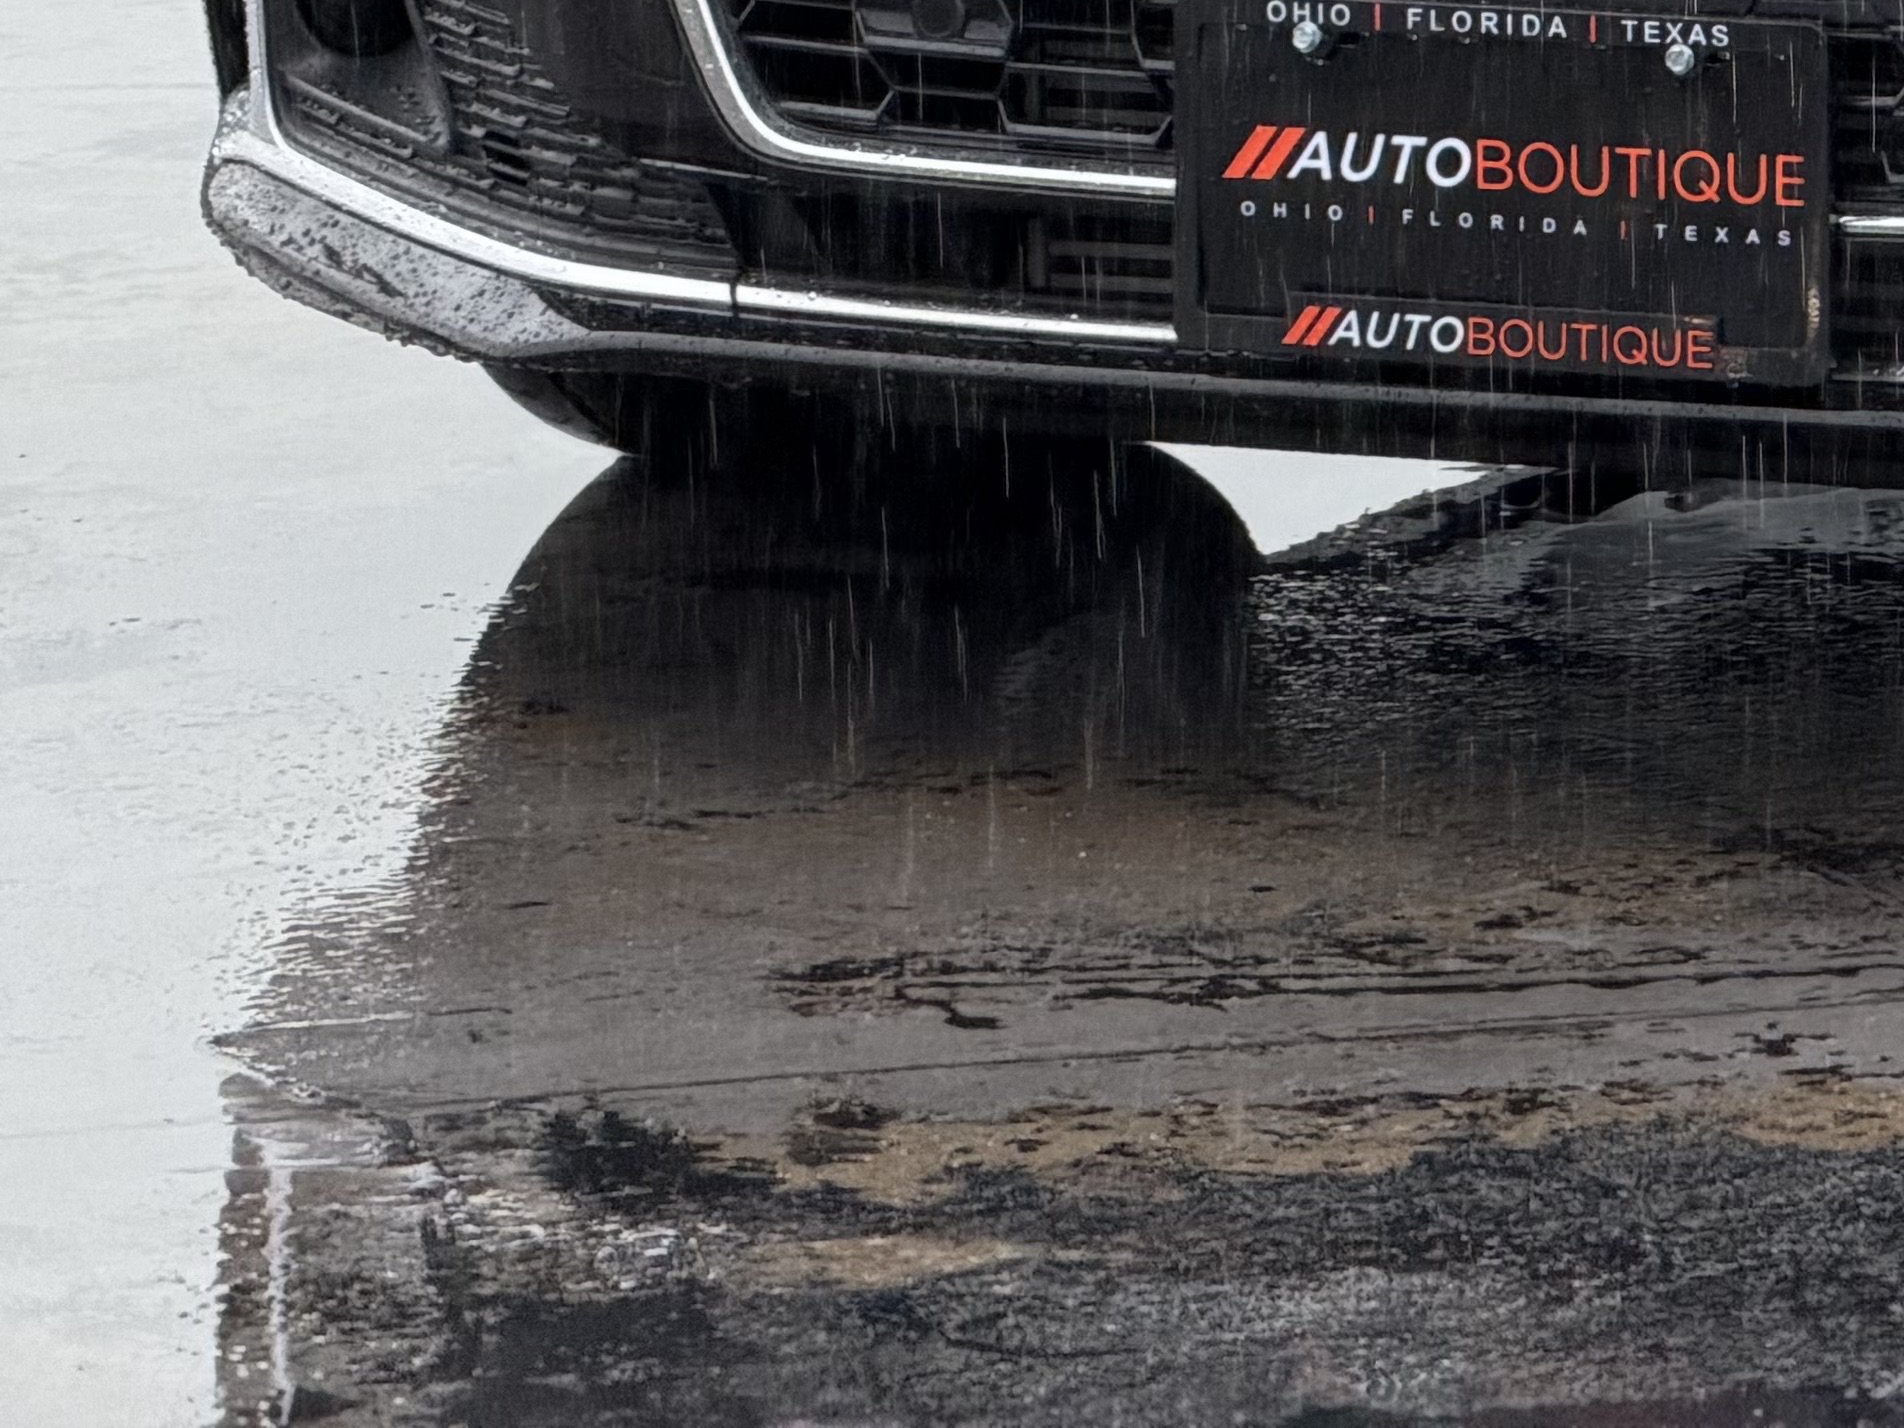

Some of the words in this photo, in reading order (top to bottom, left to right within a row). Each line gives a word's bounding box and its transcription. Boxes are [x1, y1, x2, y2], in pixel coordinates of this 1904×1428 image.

[1266, 0, 1351, 26] OHIO
[1406, 8, 1568, 39] FLORIDA
[1620, 19, 1730, 47] TEXAS
[1240, 200, 1344, 221] OHIO
[1402, 208, 1588, 236] FLORIDA
[1655, 224, 1792, 247] TEXAS
